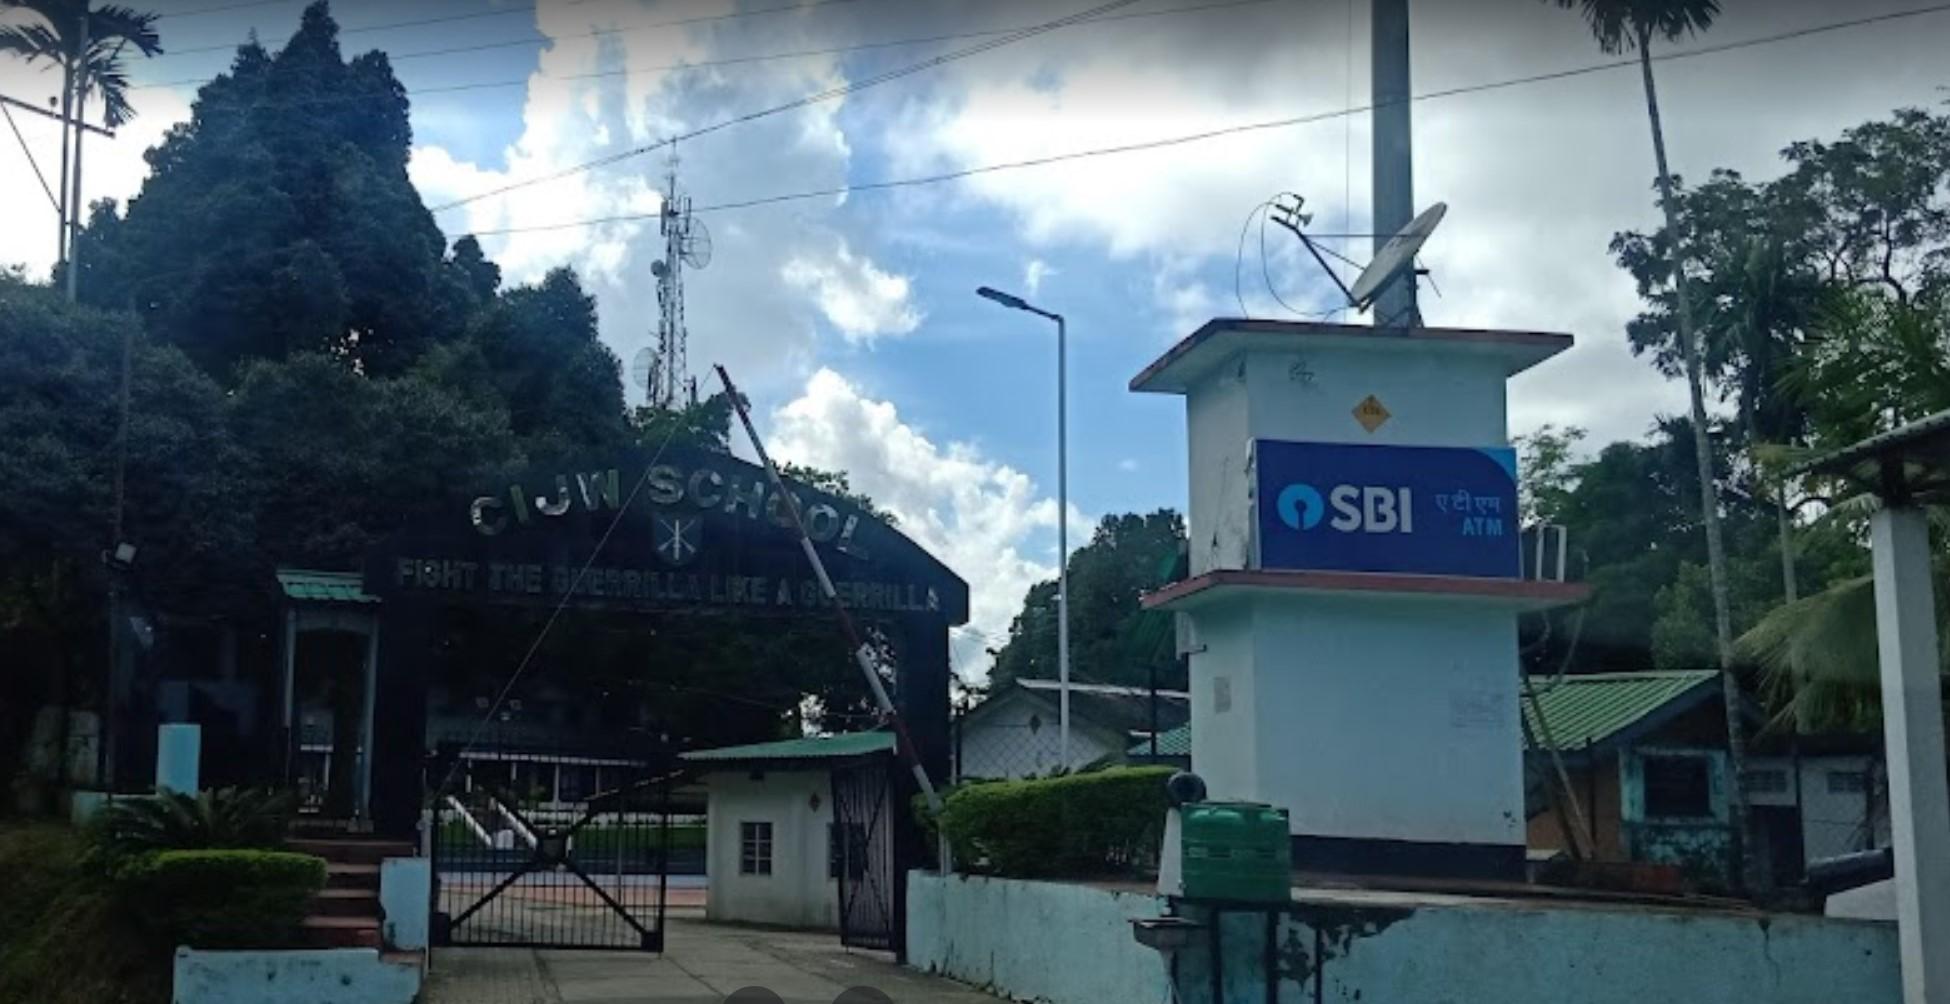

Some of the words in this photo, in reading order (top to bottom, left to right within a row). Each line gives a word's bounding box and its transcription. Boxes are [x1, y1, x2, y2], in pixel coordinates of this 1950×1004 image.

[470, 468, 620, 536] CIJW
[649, 464, 869, 560] SCHOOL
[1330, 484, 1413, 533] SBI
[1462, 517, 1502, 536] ATM
[398, 558, 478, 590] FIGHT
[489, 562, 542, 593] THE
[552, 566, 700, 600] GUERRILLA
[710, 574, 768, 604] LIKE
[776, 577, 793, 605] A
